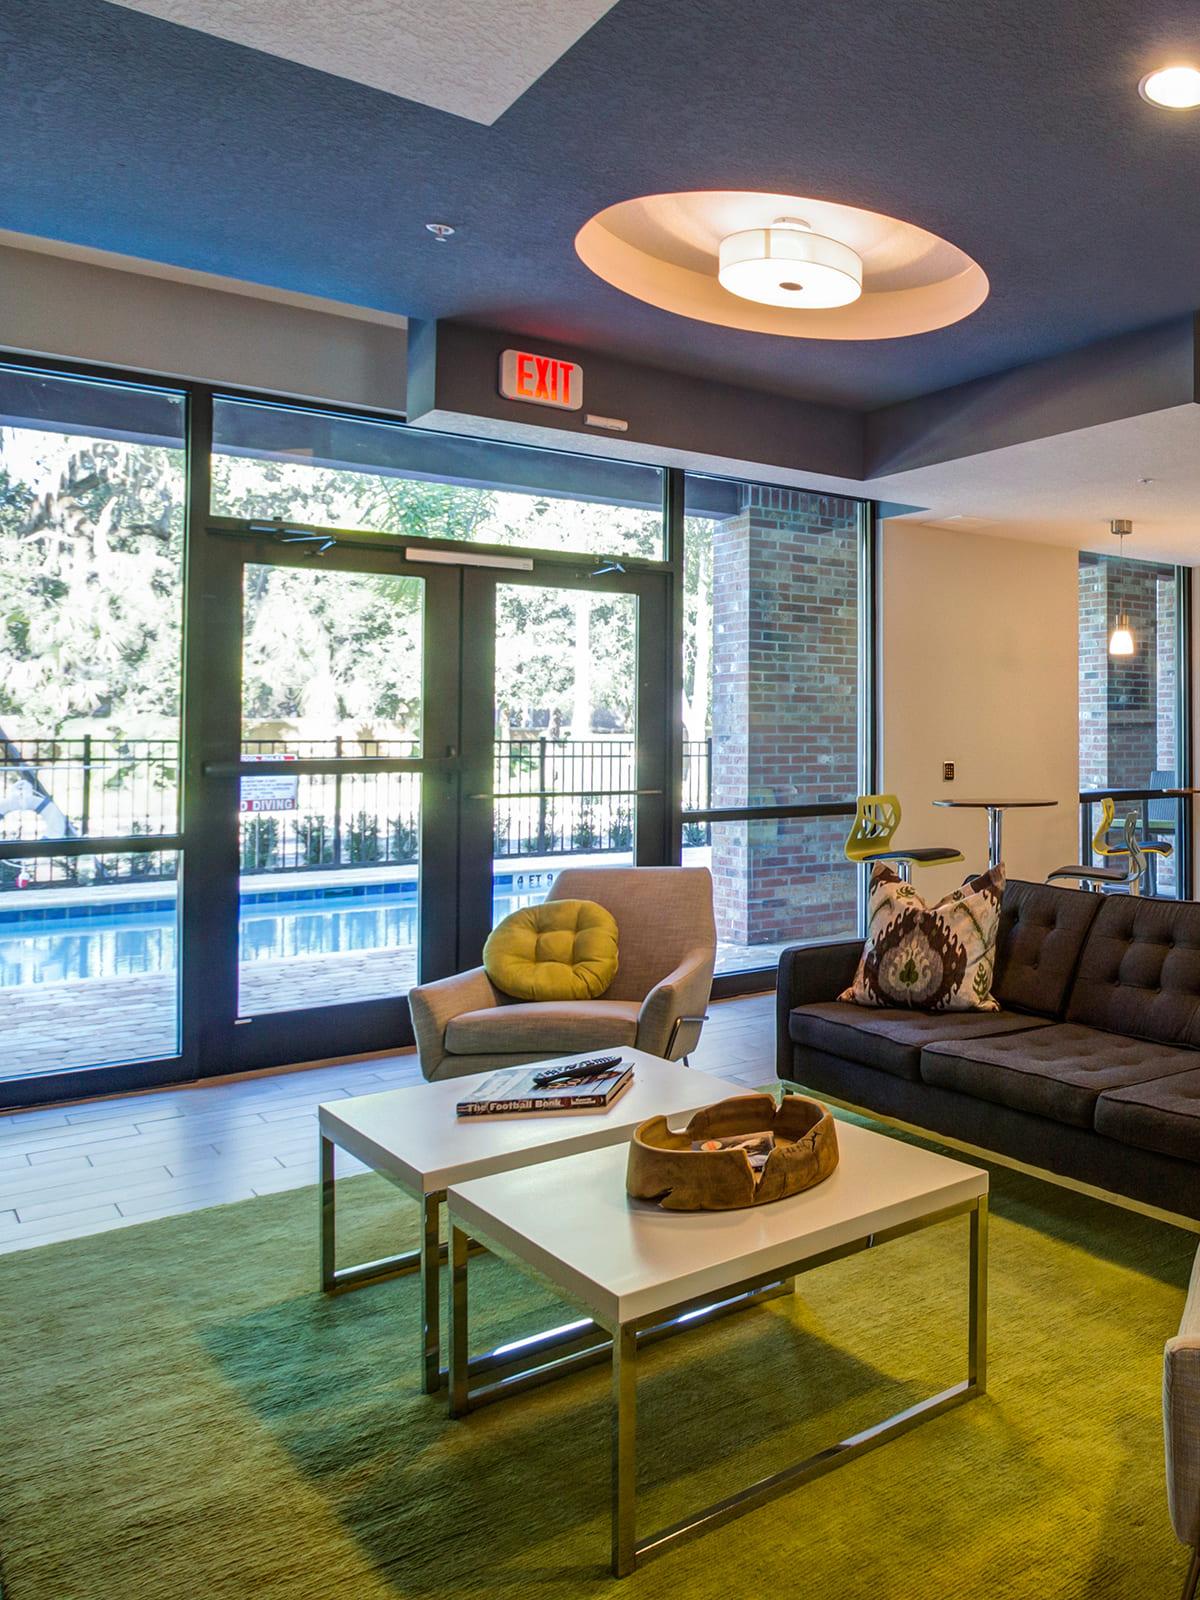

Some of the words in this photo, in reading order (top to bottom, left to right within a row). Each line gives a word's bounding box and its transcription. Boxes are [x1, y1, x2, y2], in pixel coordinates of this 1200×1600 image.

[517, 352, 574, 404] EXIT
[252, 799, 293, 811] DIVING
[468, 1104, 488, 1112] The
[490, 1100, 532, 1111] Football
[535, 1098, 561, 1108] Book
